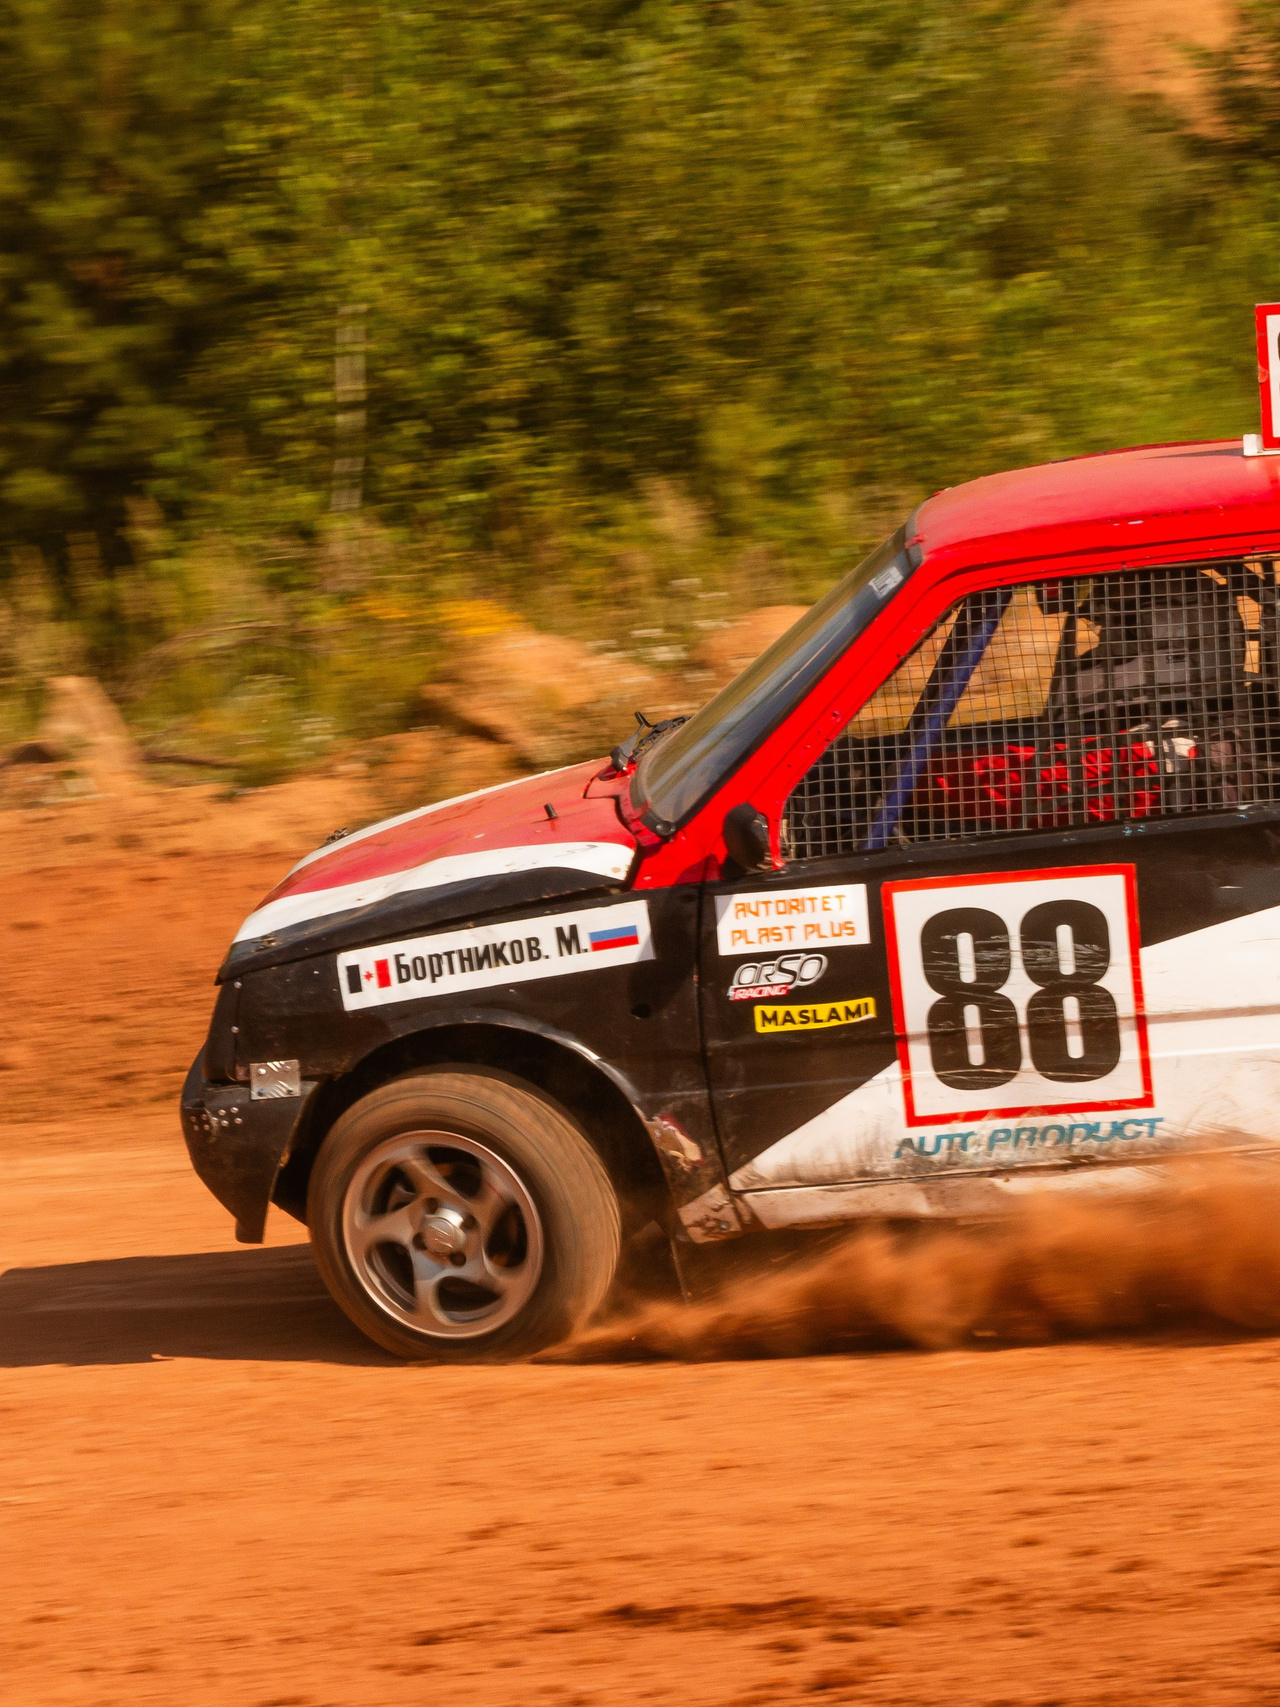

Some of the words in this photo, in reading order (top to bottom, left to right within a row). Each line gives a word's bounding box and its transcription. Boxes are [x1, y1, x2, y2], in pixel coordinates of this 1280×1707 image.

[733, 894, 847, 920] AVTORITET
[730, 925, 797, 946] PLAST
[803, 920, 857, 941] PLUS
[394, 936, 551, 984] Бортников.
[555, 924, 589, 957] М.
[733, 984, 789, 1000] RACING
[920, 899, 1121, 1091] 88
[760, 1002, 870, 1027] MASLAMI
[988, 1116, 1164, 1151] PRODUCT
